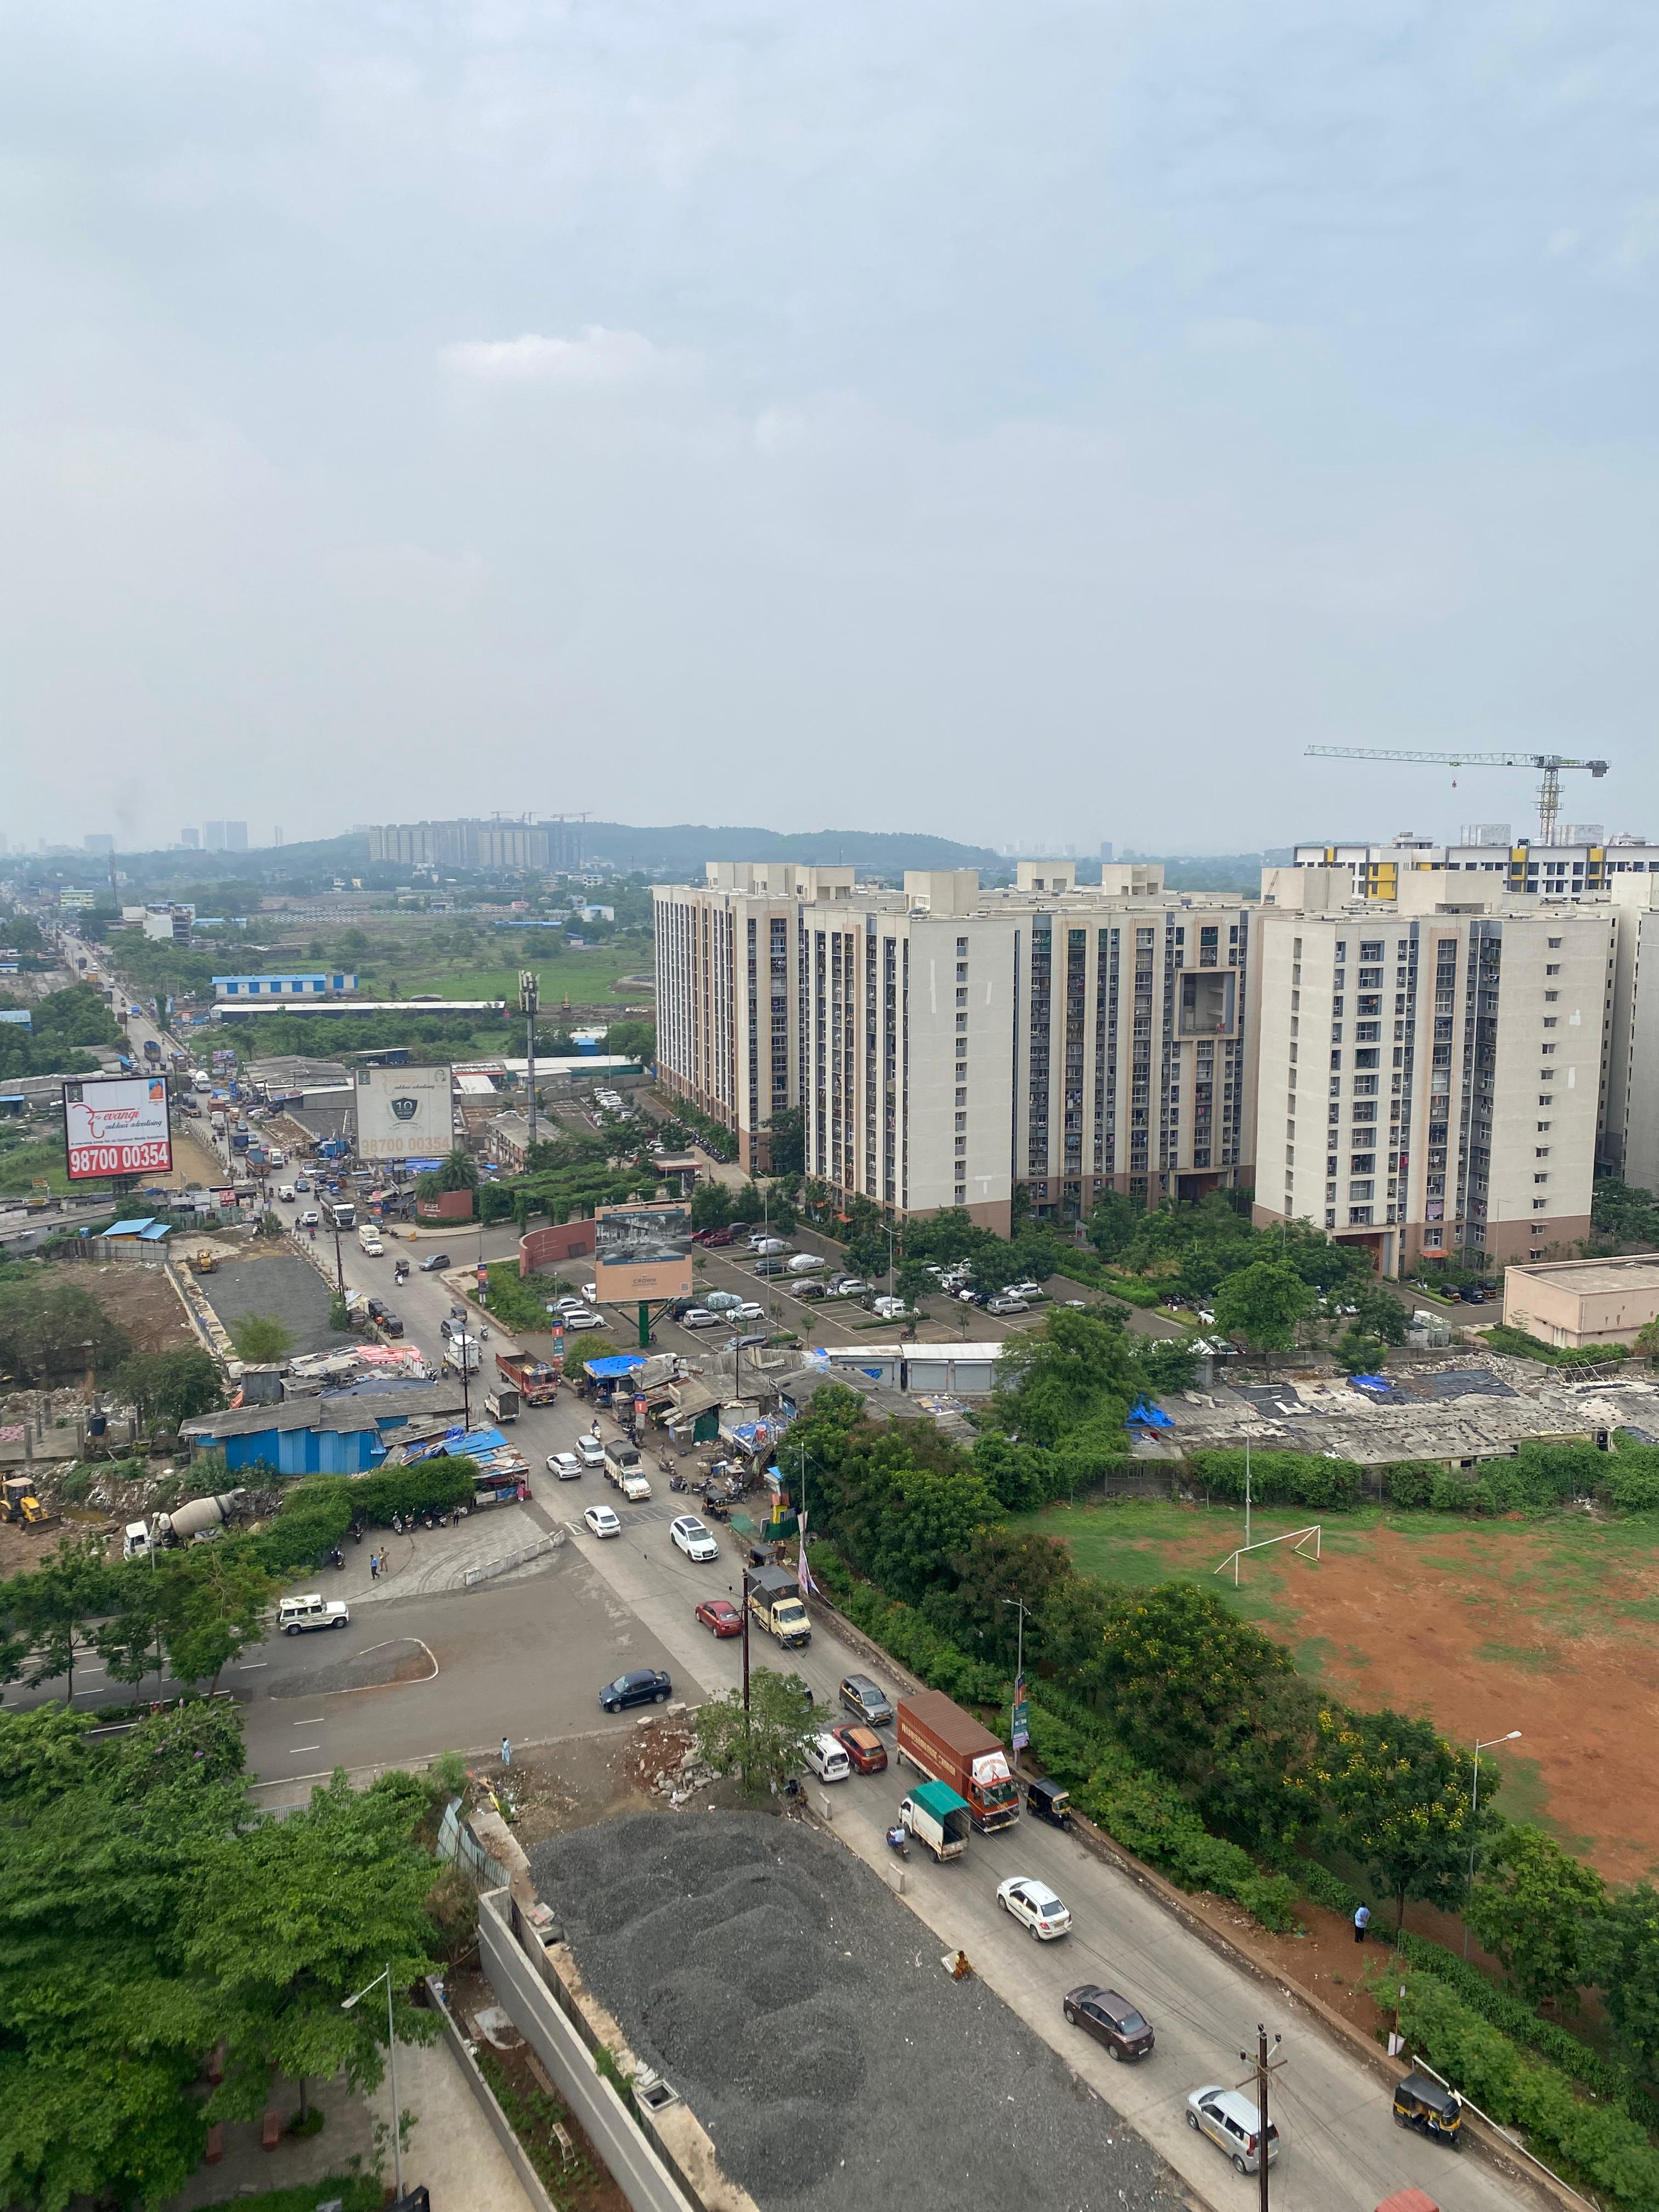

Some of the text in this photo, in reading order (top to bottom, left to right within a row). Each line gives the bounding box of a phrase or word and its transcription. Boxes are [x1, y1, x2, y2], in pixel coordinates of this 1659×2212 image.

[396, 1101, 413, 1110] 10
[105, 1119, 162, 1130] outdoor advertising
[362, 1137, 450, 1153] 98700 00354
[70, 1143, 168, 1172] 98700 00354
